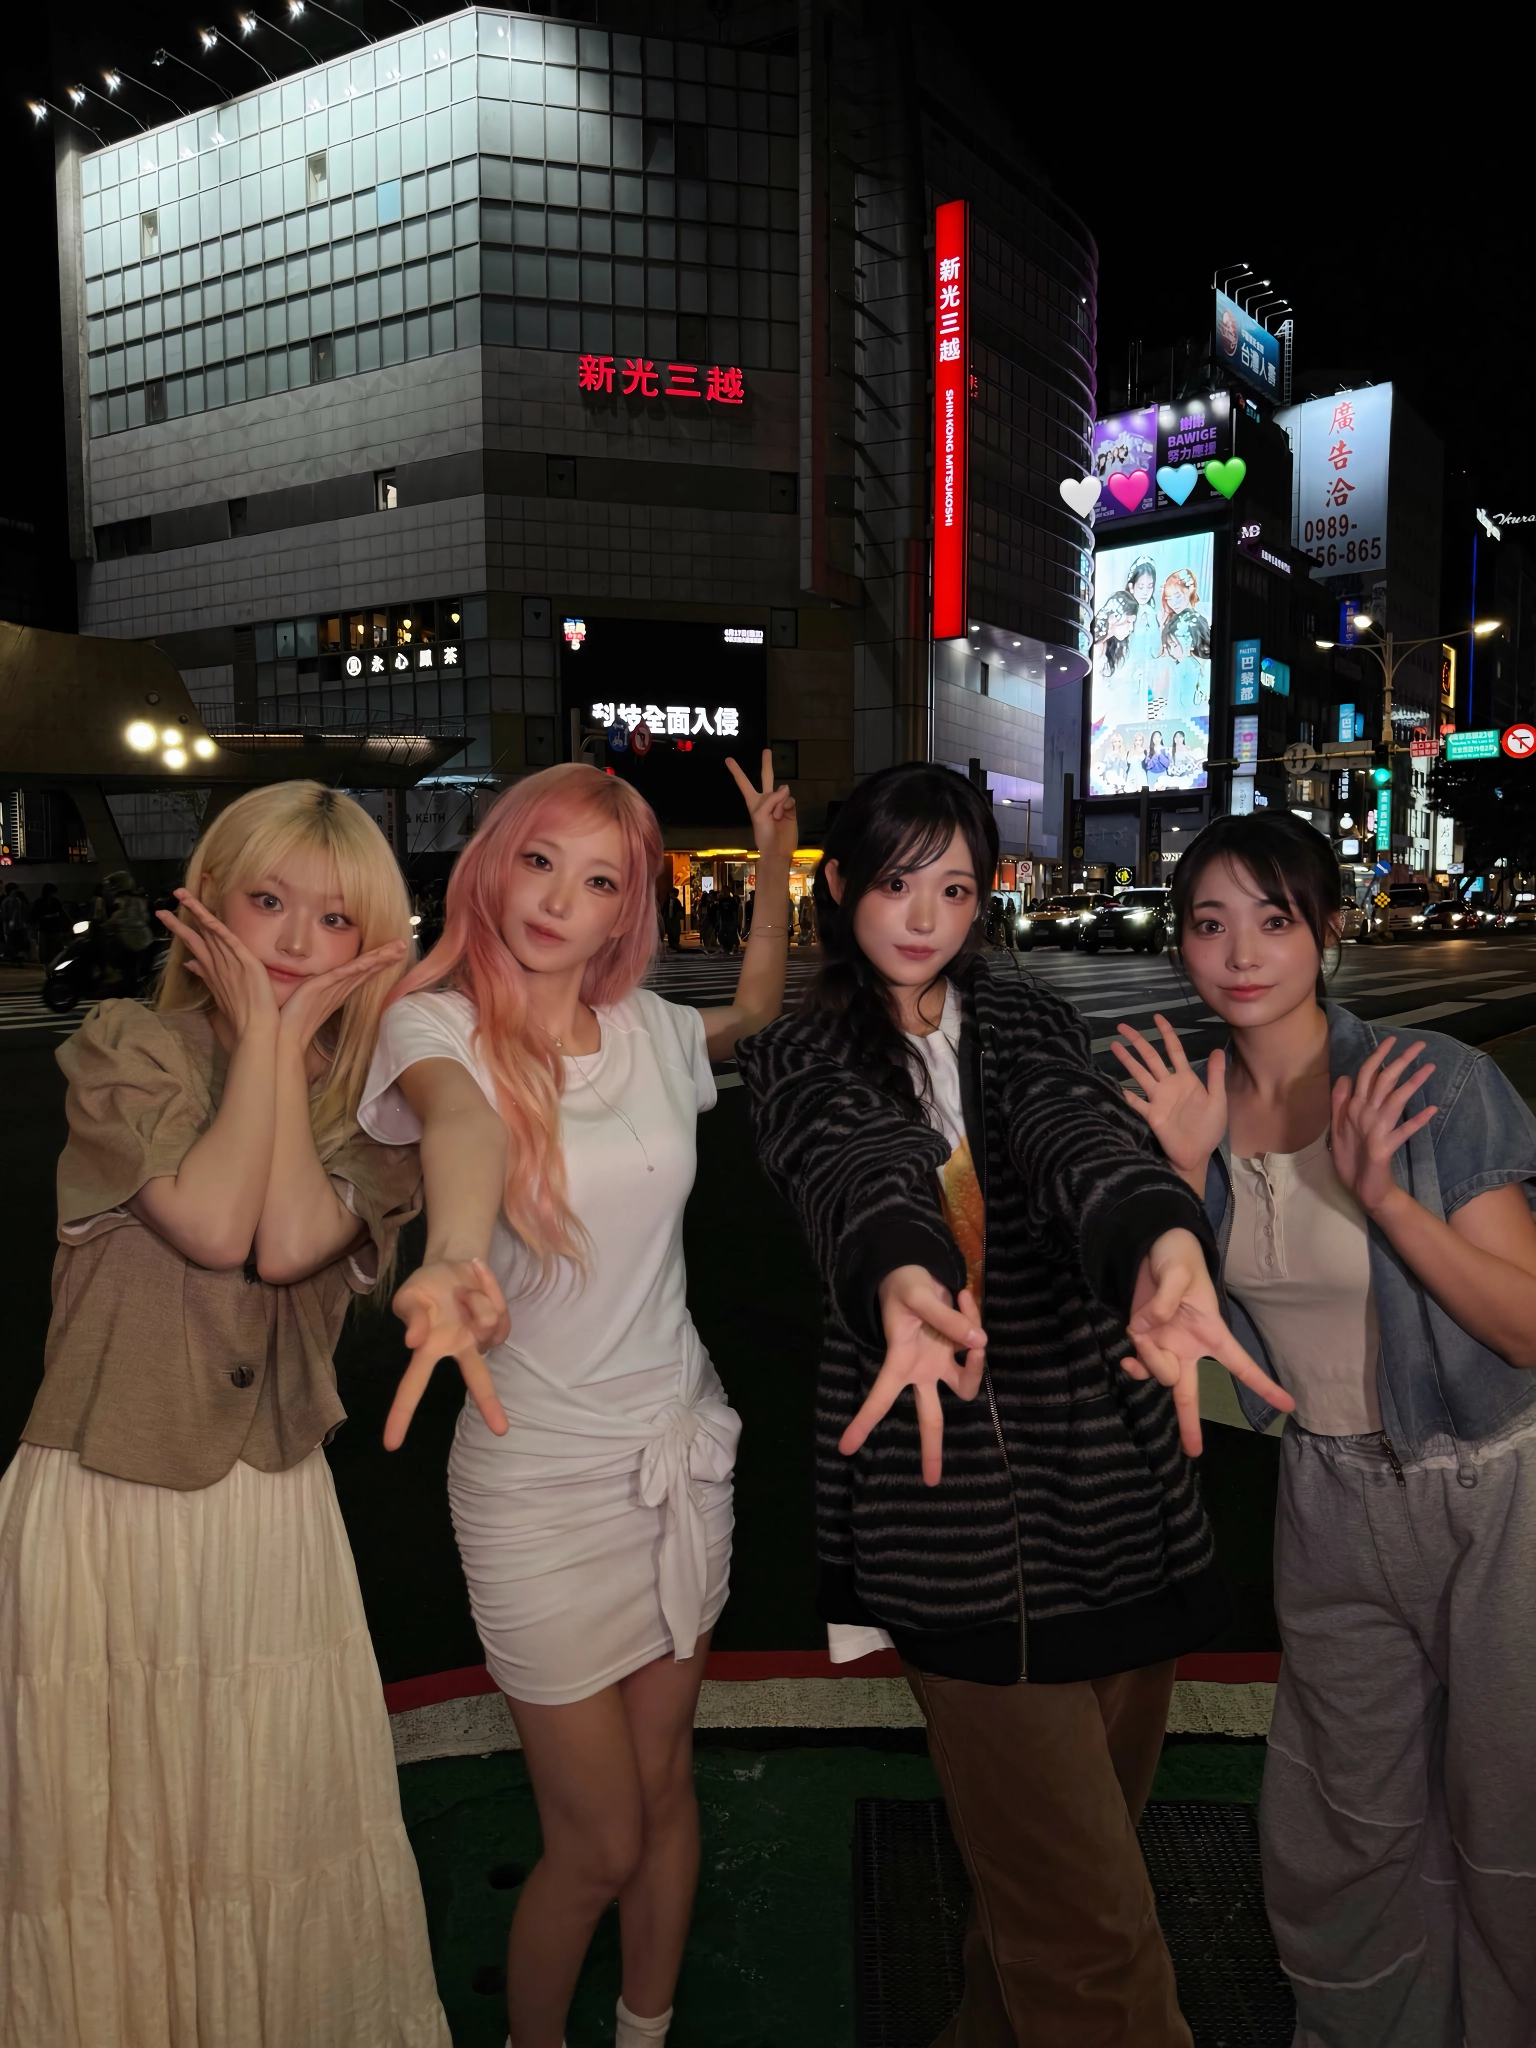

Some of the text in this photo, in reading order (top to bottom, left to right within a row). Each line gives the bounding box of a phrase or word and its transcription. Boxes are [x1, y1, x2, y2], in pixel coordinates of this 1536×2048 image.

[940, 256, 961, 363] 新光三越
[578, 354, 745, 404] 新光三越
[944, 389, 955, 527] SHIN KONG MITSUKOSHI
[1168, 427, 1217, 448] BAWIGE
[1326, 402, 1356, 508] 廣告洽
[1304, 514, 1358, 543] 0989-
[416, 812, 446, 824] KEITH
